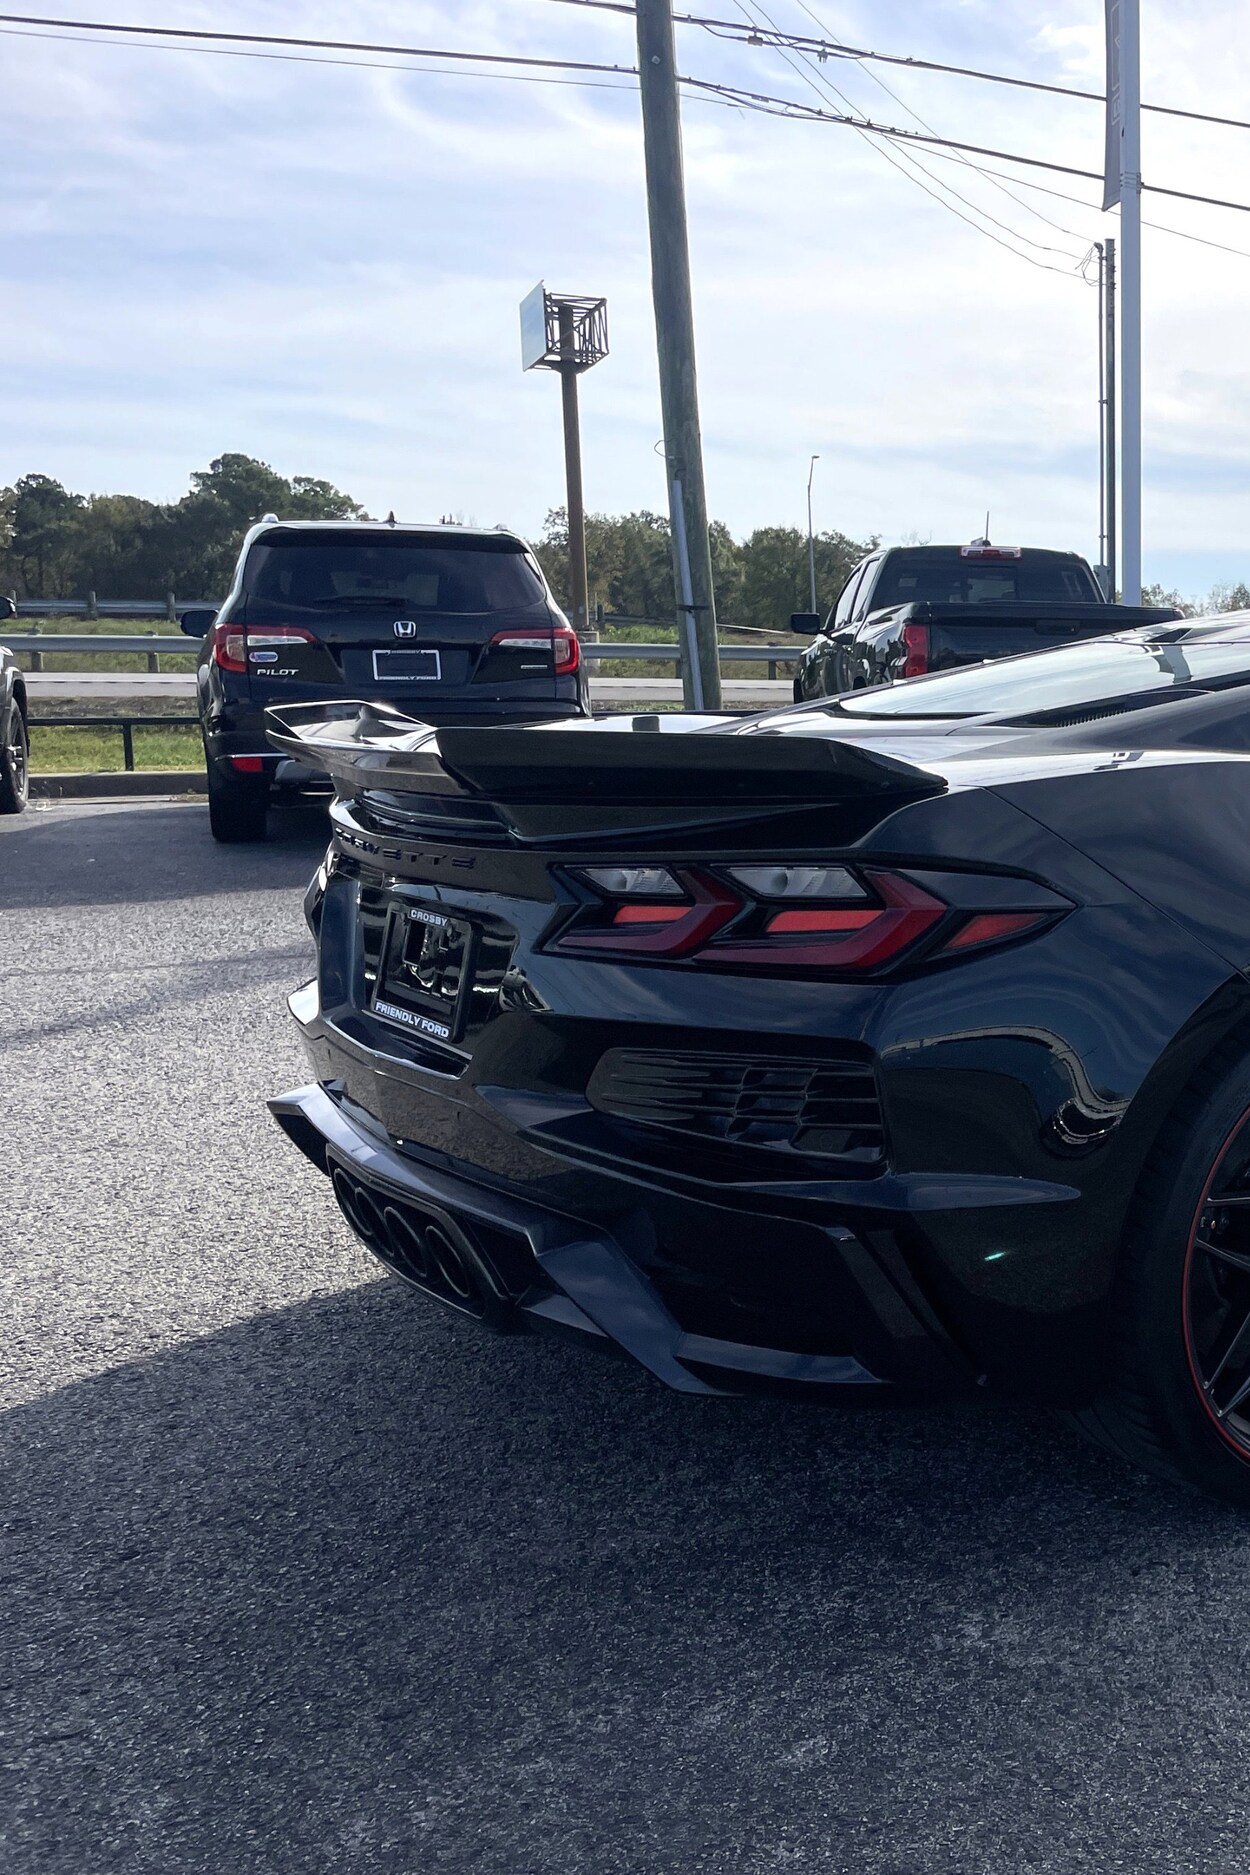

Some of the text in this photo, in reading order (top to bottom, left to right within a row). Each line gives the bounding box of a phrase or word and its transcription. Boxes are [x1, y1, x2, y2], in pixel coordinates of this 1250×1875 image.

[257, 668, 300, 676] PILOT
[410, 909, 448, 927] CROSBY
[375, 1001, 450, 1038] FRIENDLY FORD
